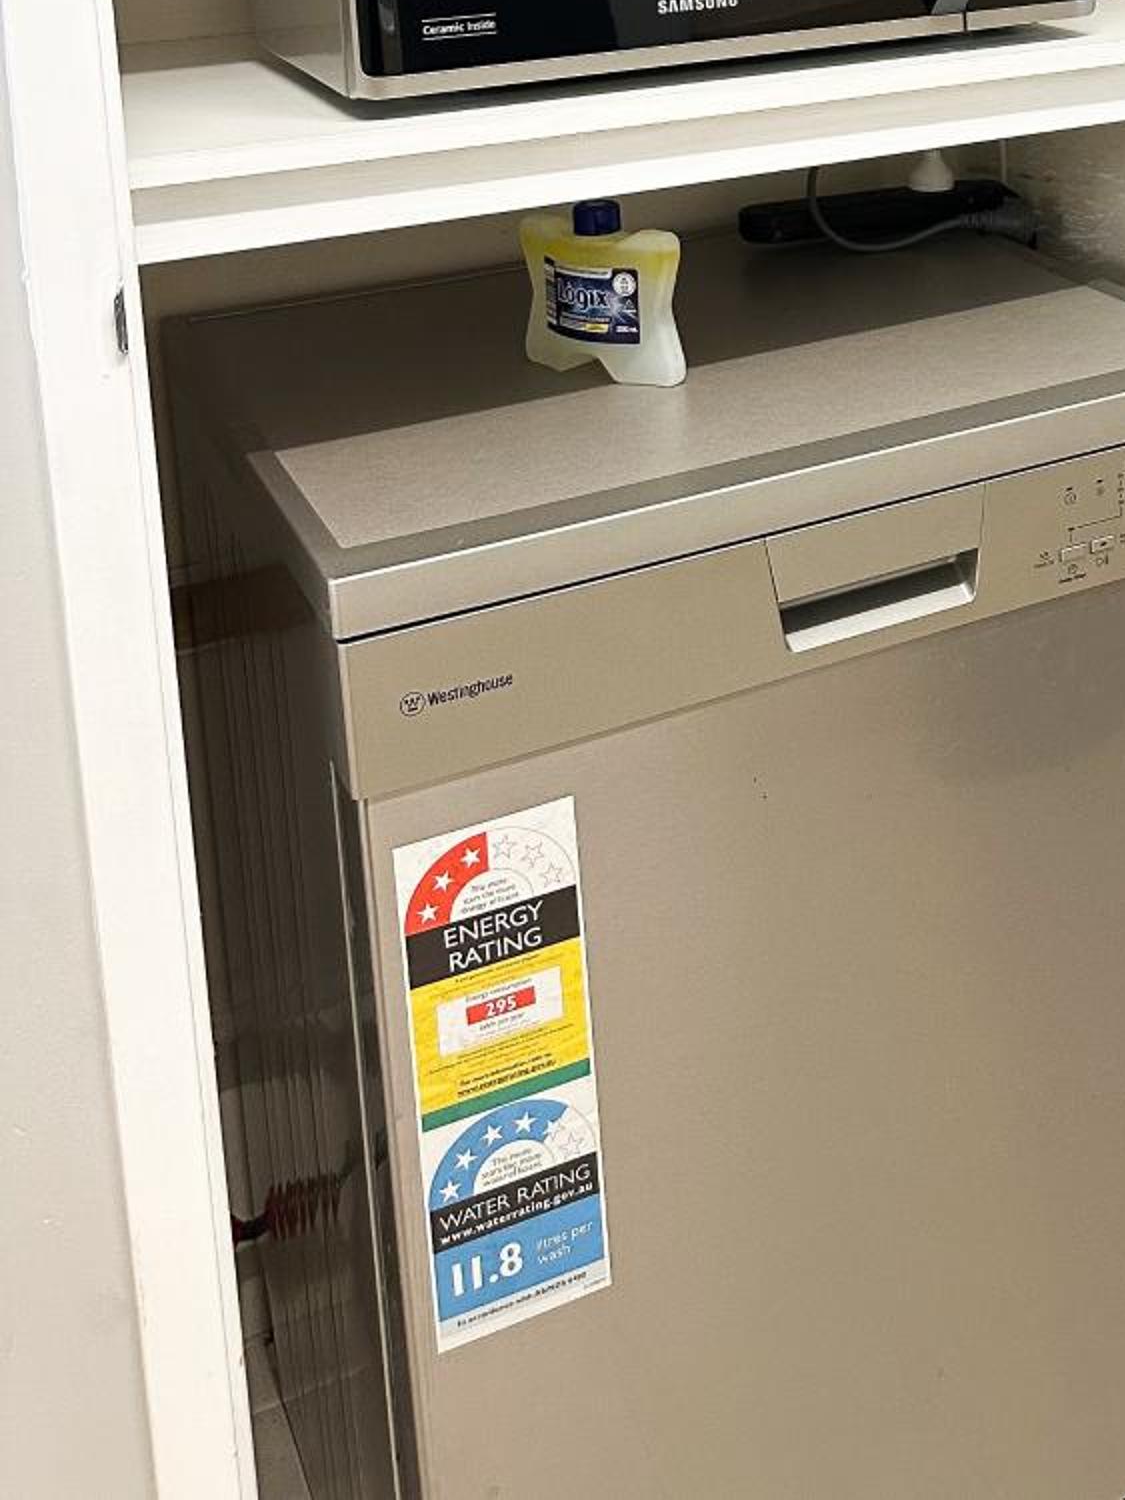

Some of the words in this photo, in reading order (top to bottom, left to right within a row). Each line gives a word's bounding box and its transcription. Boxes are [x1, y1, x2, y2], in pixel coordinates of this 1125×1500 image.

[427, 674, 513, 706] Westinghouse
[443, 900, 543, 949] ENERGY
[449, 927, 542, 972] RATING
[485, 995, 517, 1017] 295
[440, 1194, 511, 1231] WATER
[517, 1163, 591, 1203] RATING
[440, 1182, 593, 1245] www.waterrating.gov.au
[452, 1242, 524, 1297] 11.8
